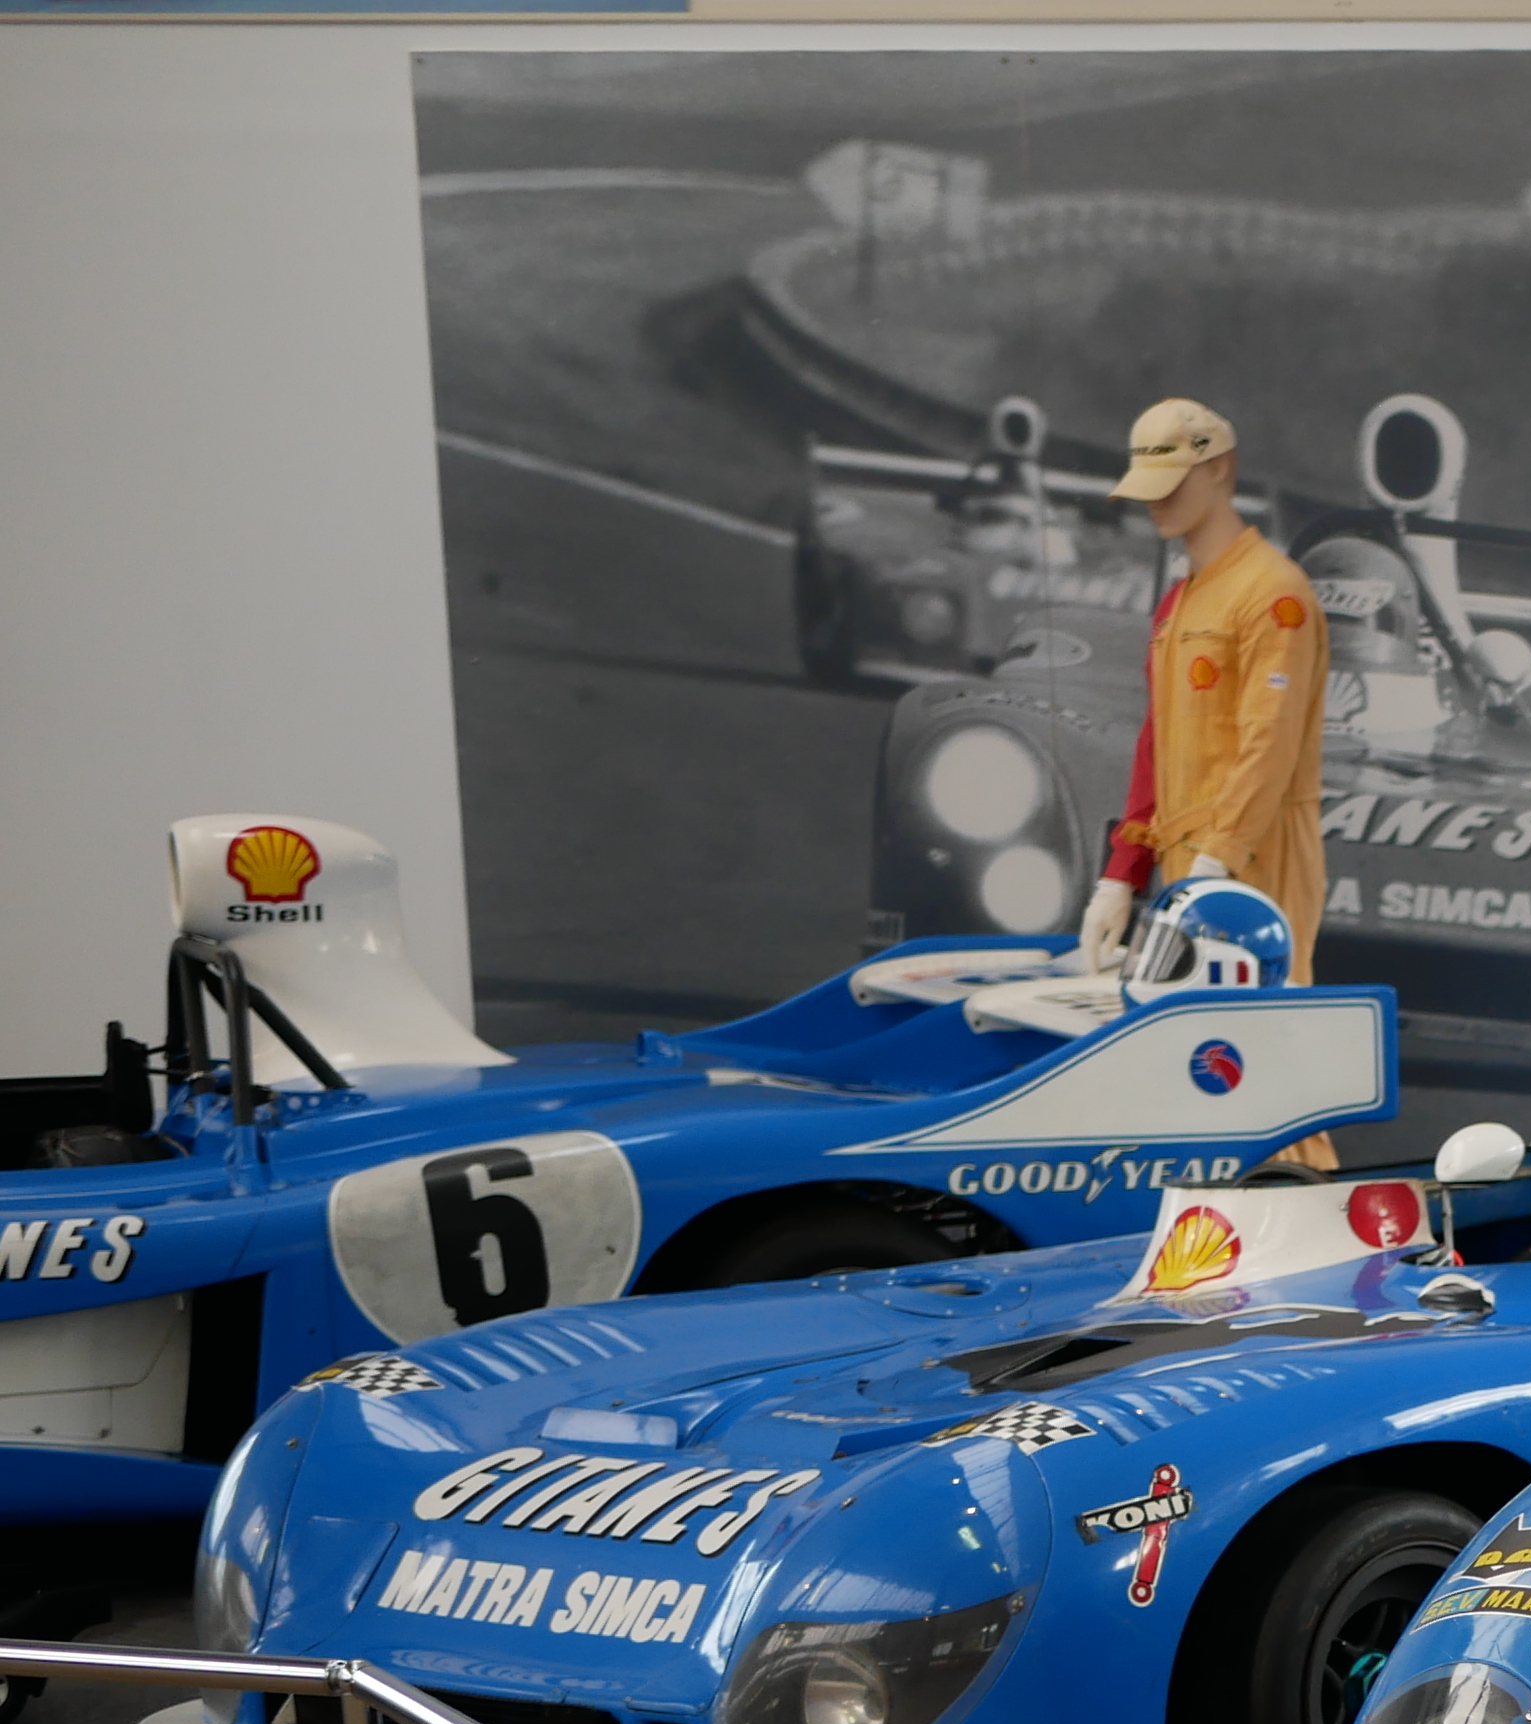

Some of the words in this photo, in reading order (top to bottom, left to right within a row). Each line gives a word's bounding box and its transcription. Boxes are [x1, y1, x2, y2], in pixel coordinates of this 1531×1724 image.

[226, 904, 323, 924] Shell
[423, 1149, 549, 1326] 6
[413, 1446, 818, 1558] GITANES
[378, 1549, 554, 1631] MATRA
[550, 1571, 704, 1645] SIMCA
